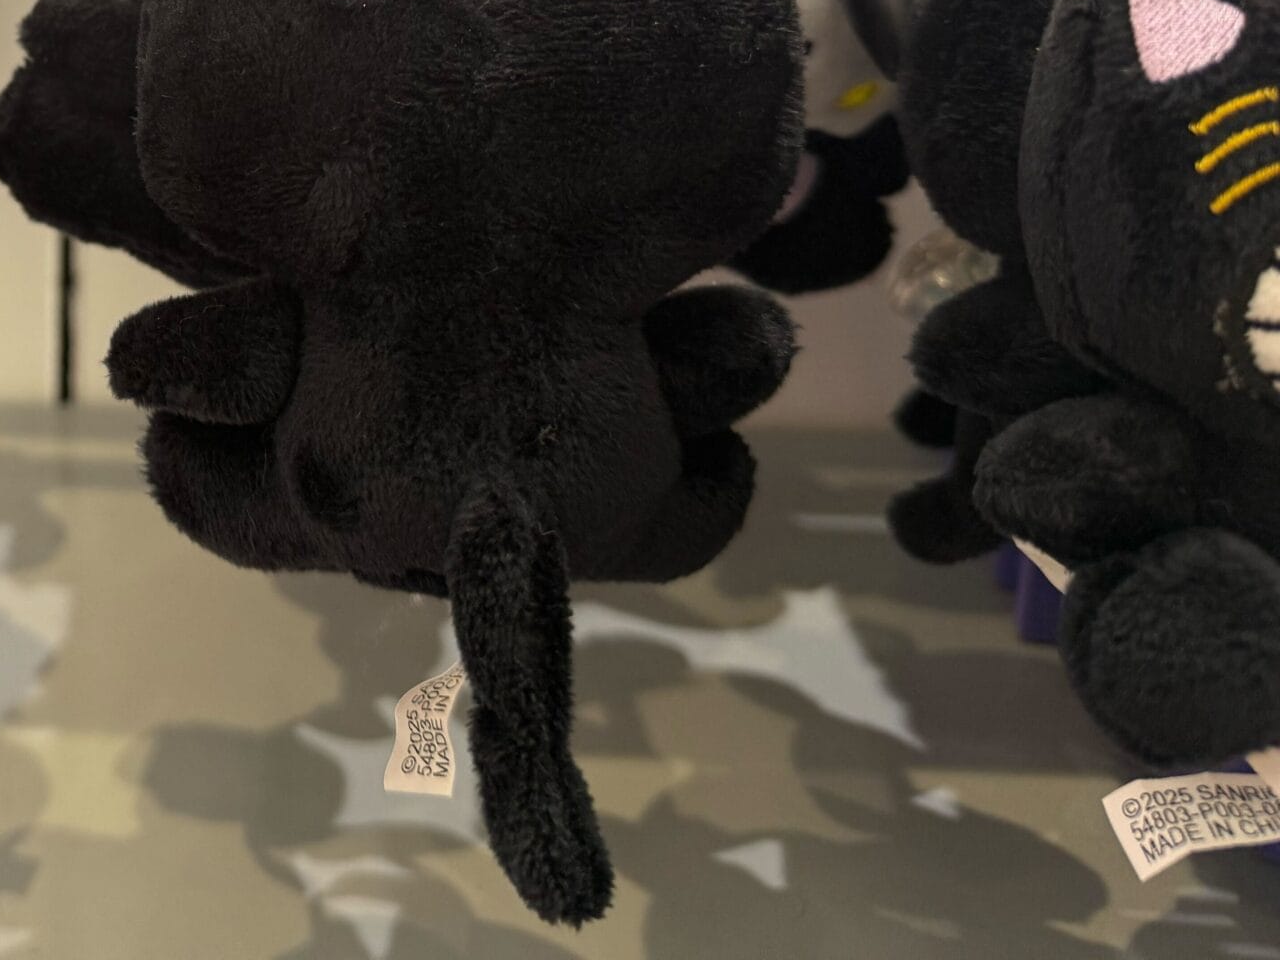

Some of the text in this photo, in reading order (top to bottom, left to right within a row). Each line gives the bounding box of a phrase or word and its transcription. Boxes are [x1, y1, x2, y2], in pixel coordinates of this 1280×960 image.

[431, 694, 450, 777] MADE IN
[1140, 817, 1280, 863] MADE IN CHI
